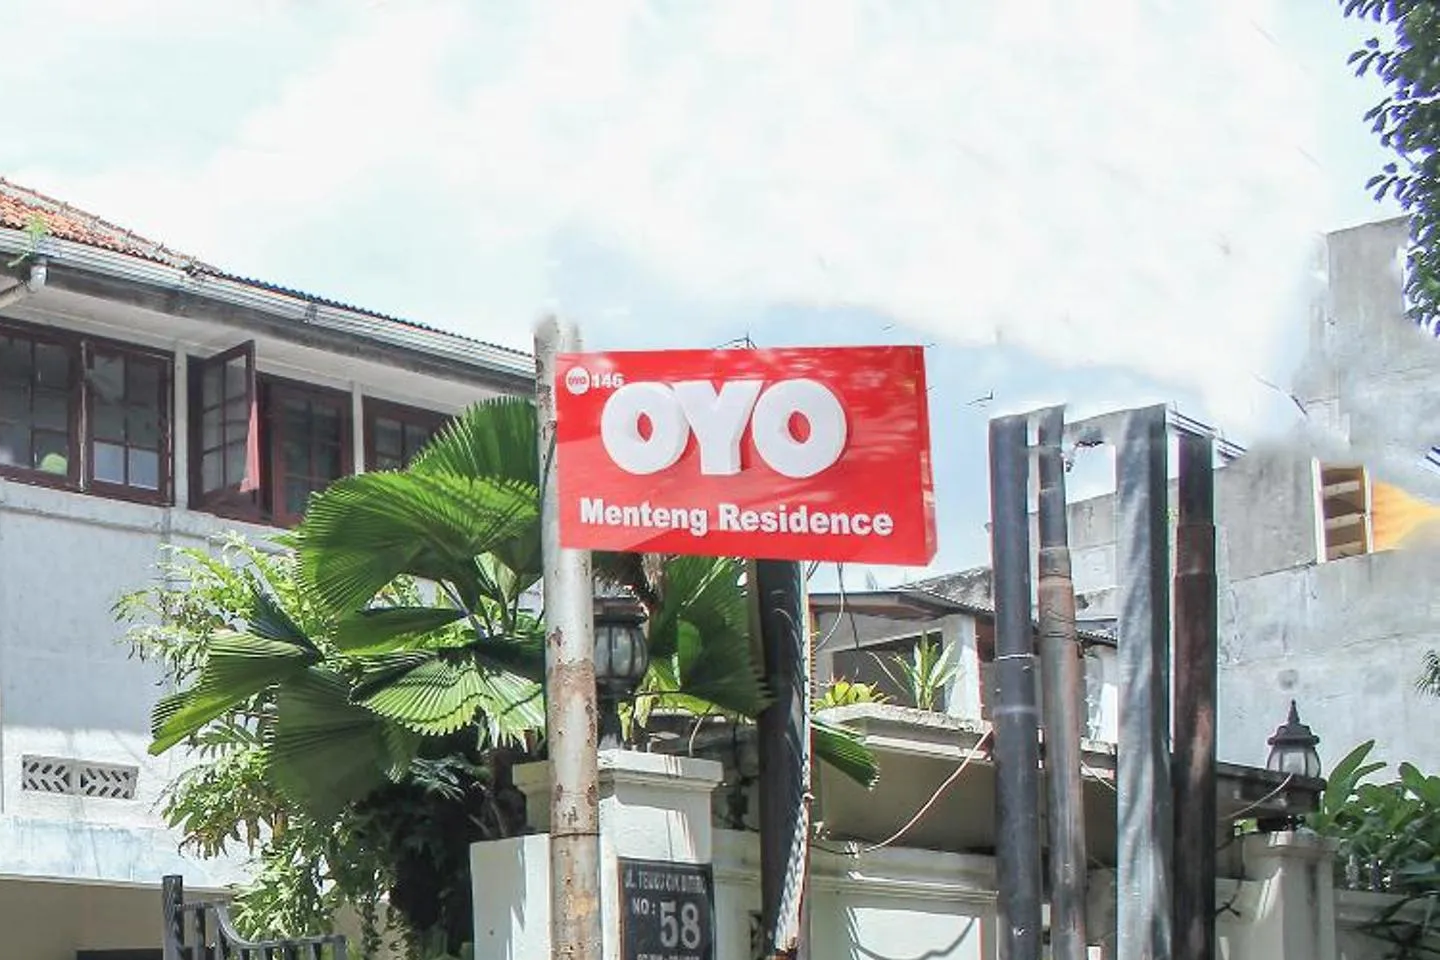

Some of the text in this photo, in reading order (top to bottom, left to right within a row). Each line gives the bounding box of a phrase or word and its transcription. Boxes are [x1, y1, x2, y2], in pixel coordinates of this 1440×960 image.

[600, 378, 848, 478] OYO
[580, 497, 895, 536] Menteng Residence
[660, 901, 701, 949] 58
